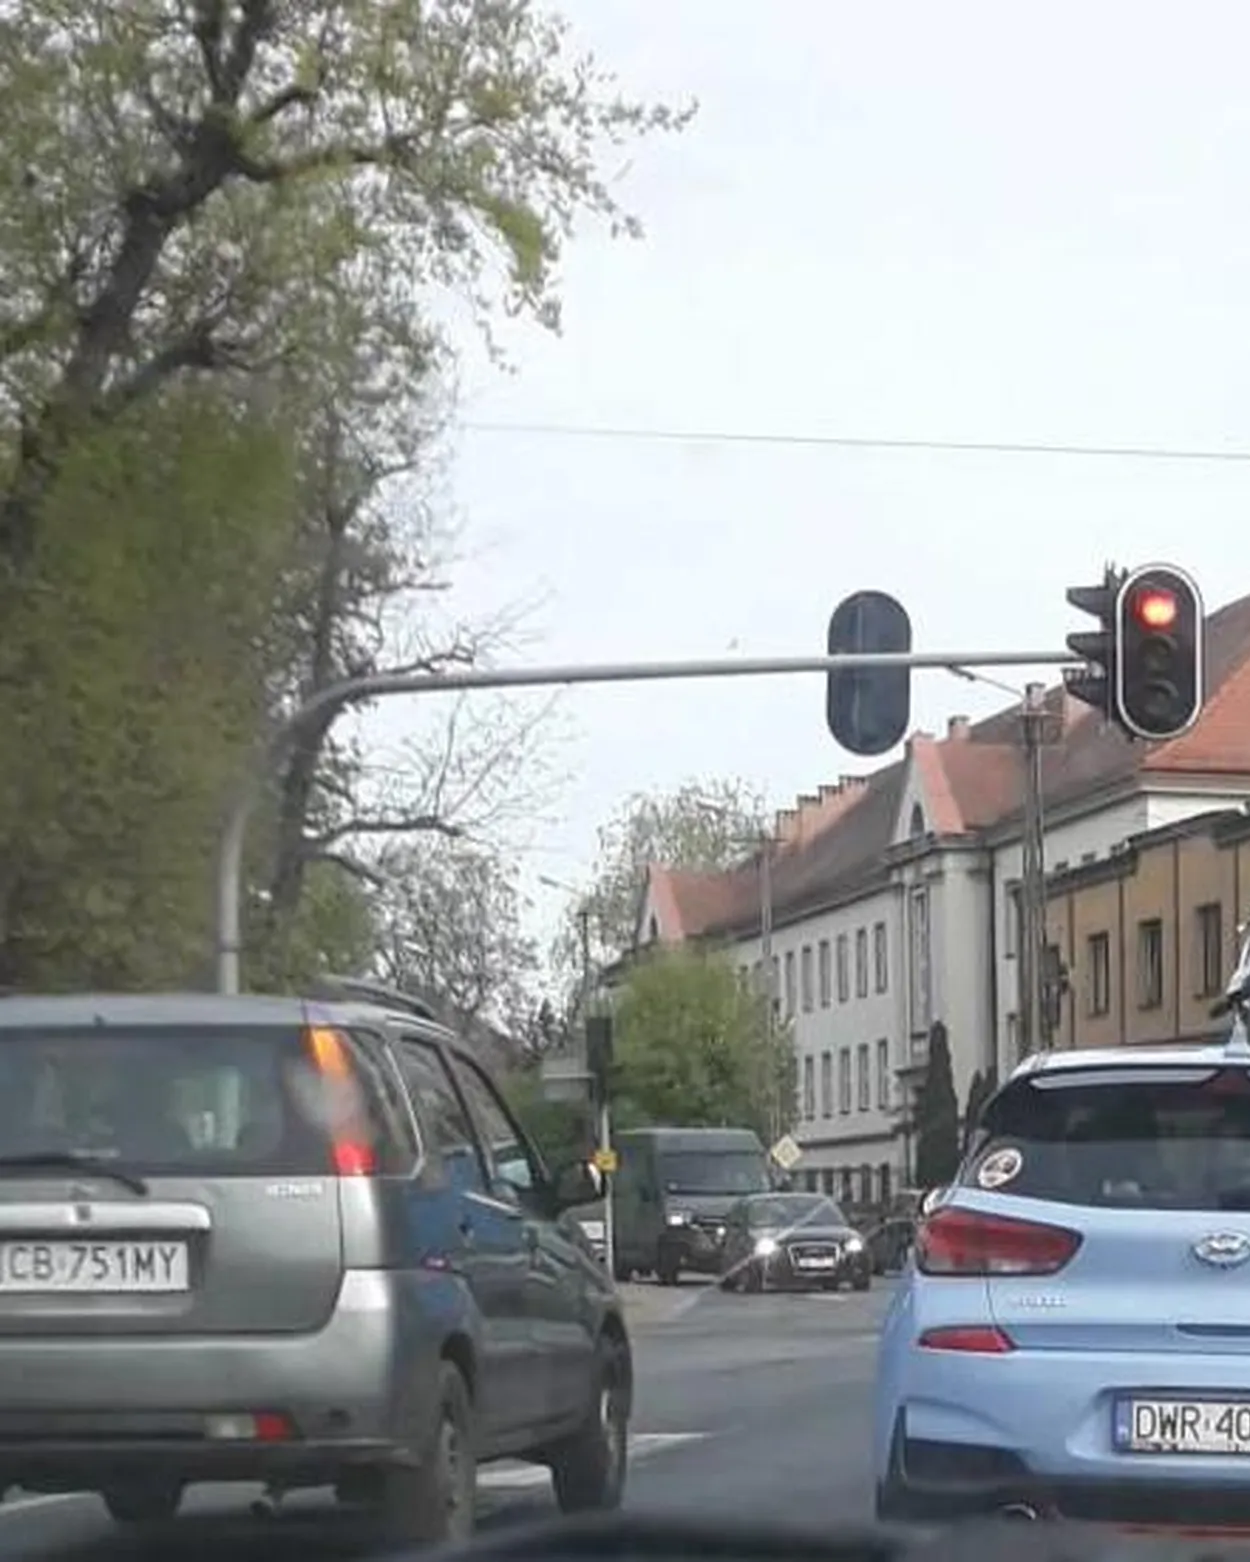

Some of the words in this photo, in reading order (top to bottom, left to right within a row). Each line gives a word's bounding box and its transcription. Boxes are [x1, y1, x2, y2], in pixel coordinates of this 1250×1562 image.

[9, 1246, 54, 1280] CB
[69, 1246, 179, 1281] 751MY
[1135, 1405, 1200, 1442] DWR
